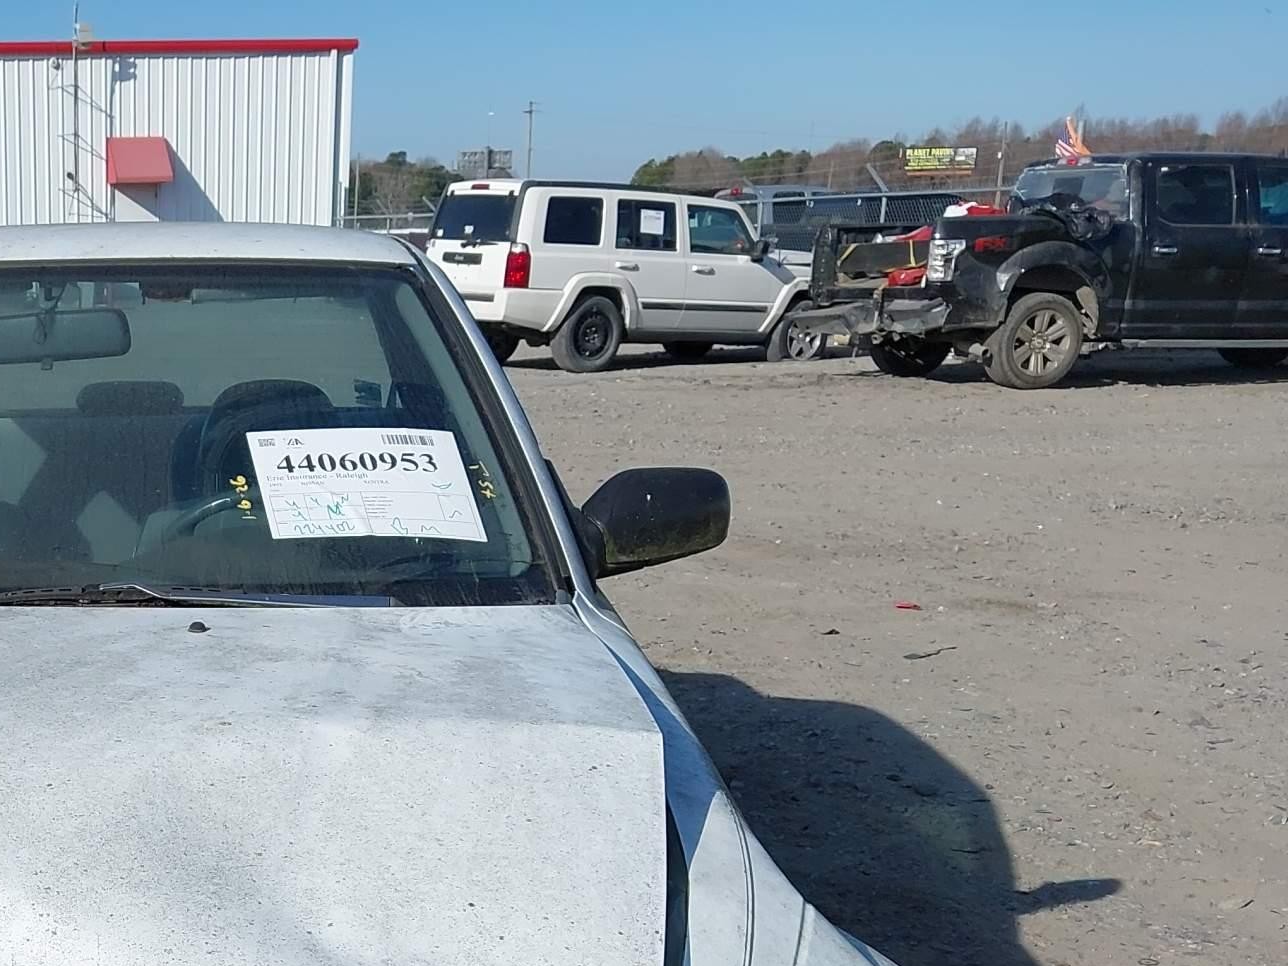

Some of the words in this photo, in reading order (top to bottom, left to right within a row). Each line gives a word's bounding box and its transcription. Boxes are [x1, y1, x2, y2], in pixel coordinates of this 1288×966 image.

[276, 452, 439, 473] 44060953
[287, 473, 328, 481] Insurance
[335, 472, 369, 480] Raleigh
